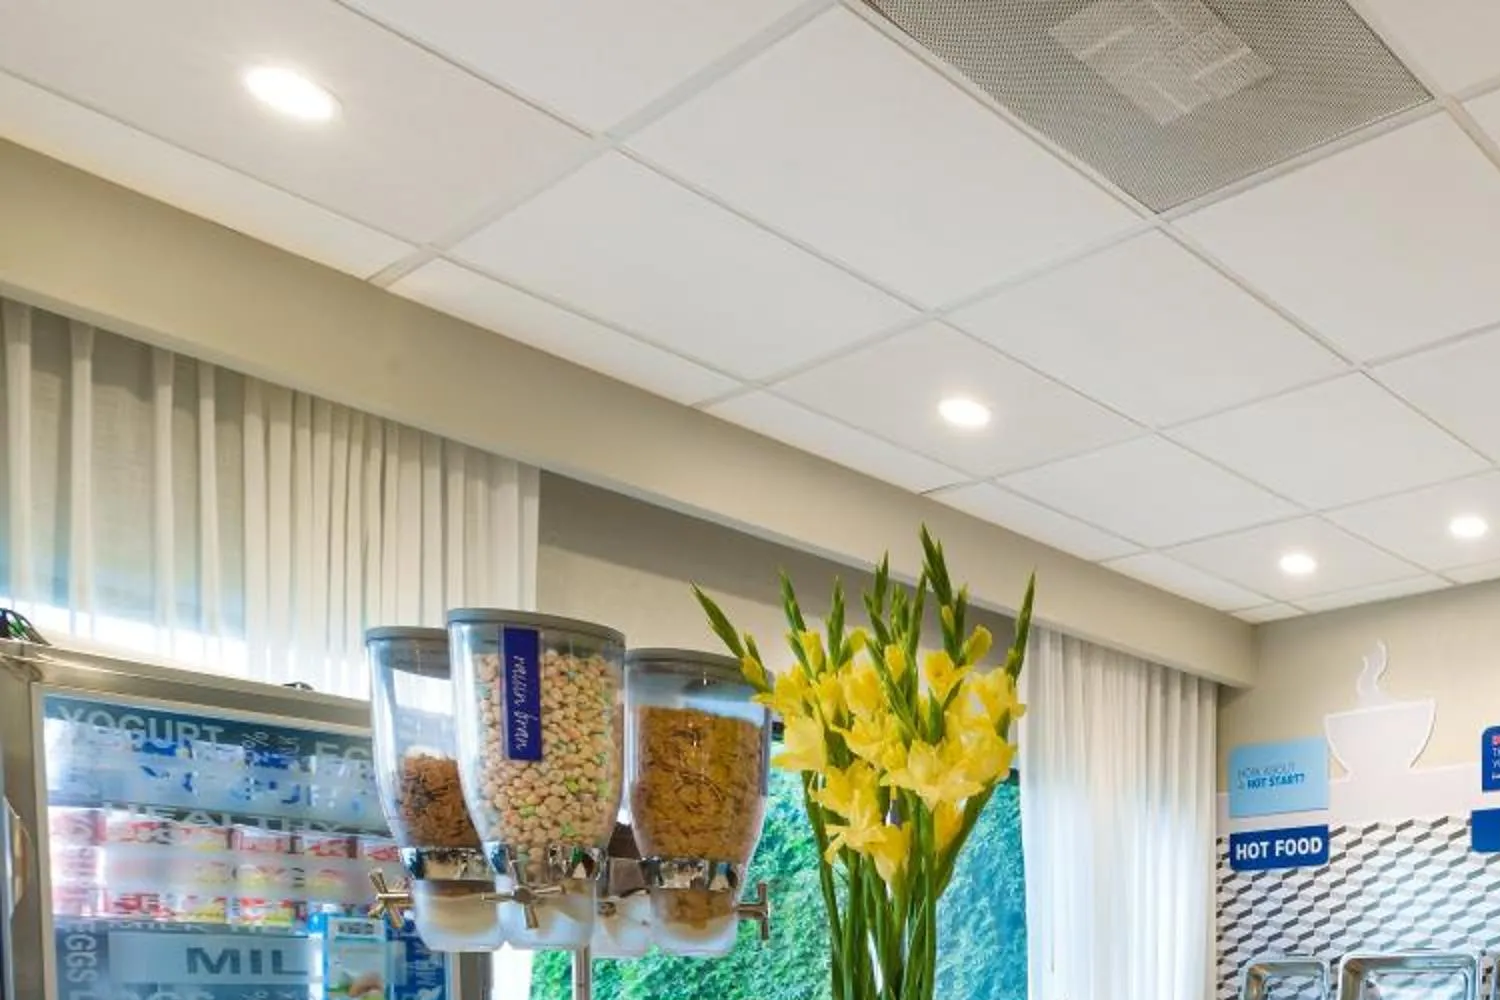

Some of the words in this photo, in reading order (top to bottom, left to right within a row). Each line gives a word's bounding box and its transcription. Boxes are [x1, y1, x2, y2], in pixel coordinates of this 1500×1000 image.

[1235, 841, 1270, 861] HOT
[1275, 836, 1323, 857] FOOD
[186, 946, 308, 975] MIL
